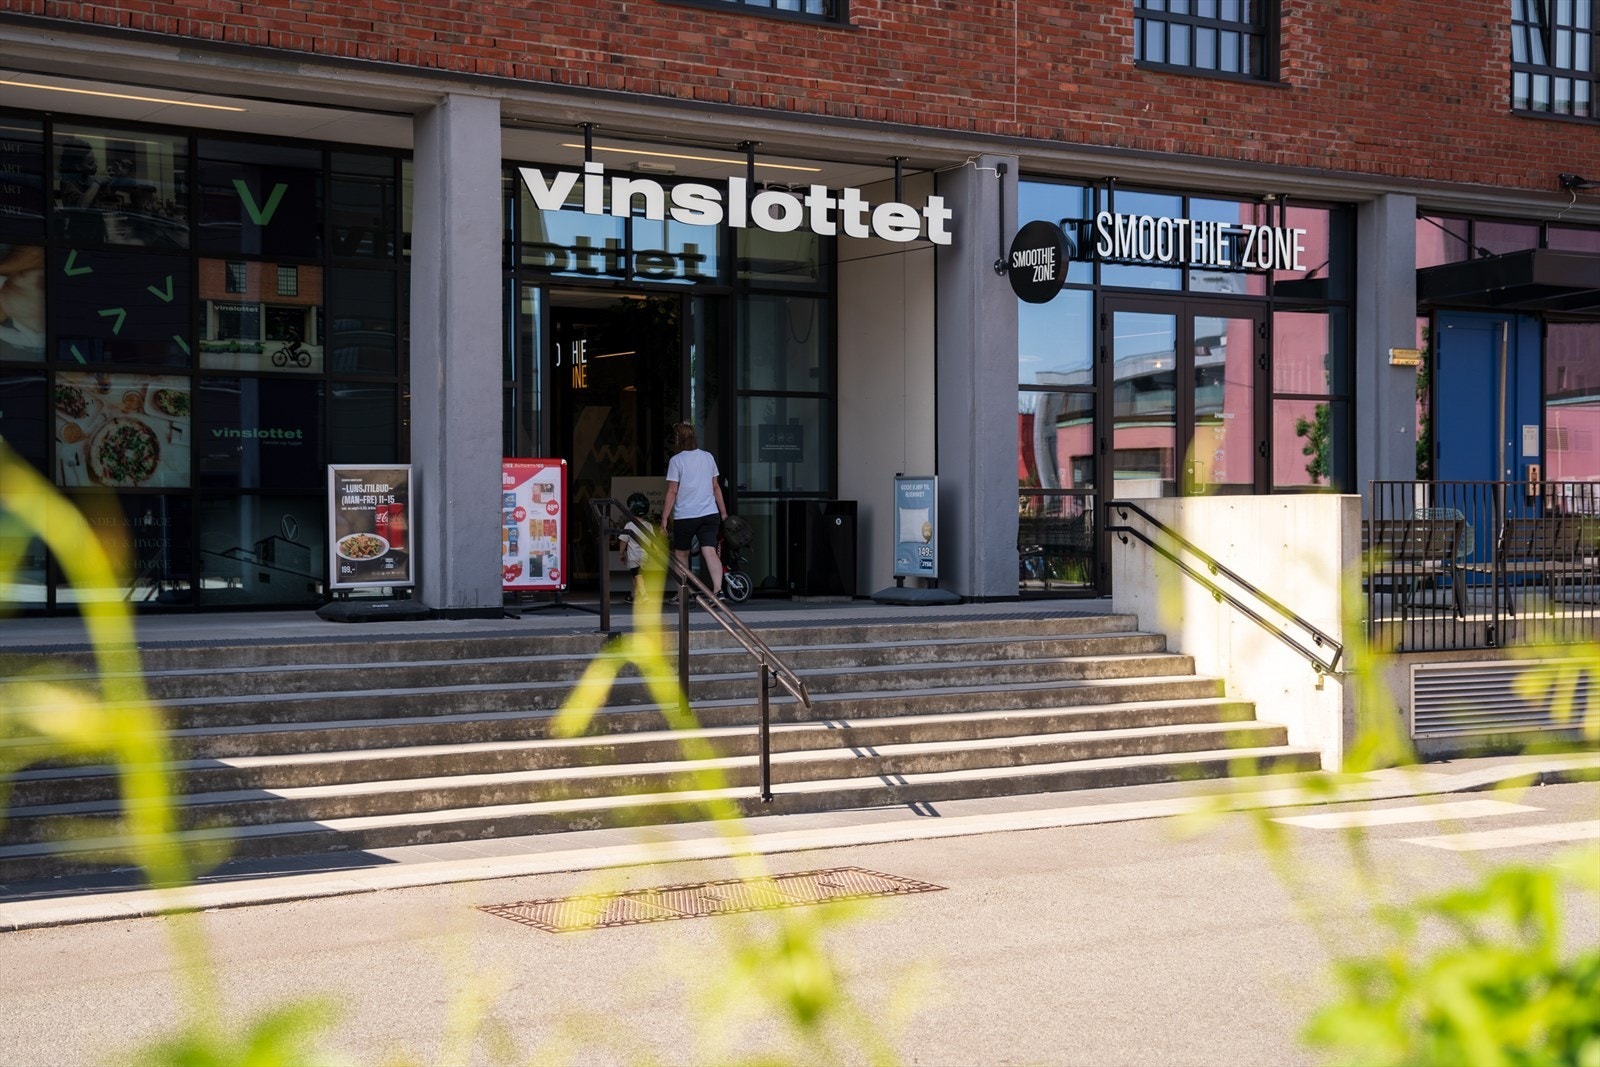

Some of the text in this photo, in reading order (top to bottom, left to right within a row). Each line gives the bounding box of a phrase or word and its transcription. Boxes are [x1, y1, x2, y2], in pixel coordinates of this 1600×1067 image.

[519, 162, 952, 247] vinslottet
[1096, 211, 1307, 272] SMOOTHIE ZONE
[1012, 246, 1056, 269] SMOOTHIE
[1032, 263, 1056, 283] ZONE
[214, 304, 259, 313] vinslottet
[211, 427, 304, 439] vinslottet
